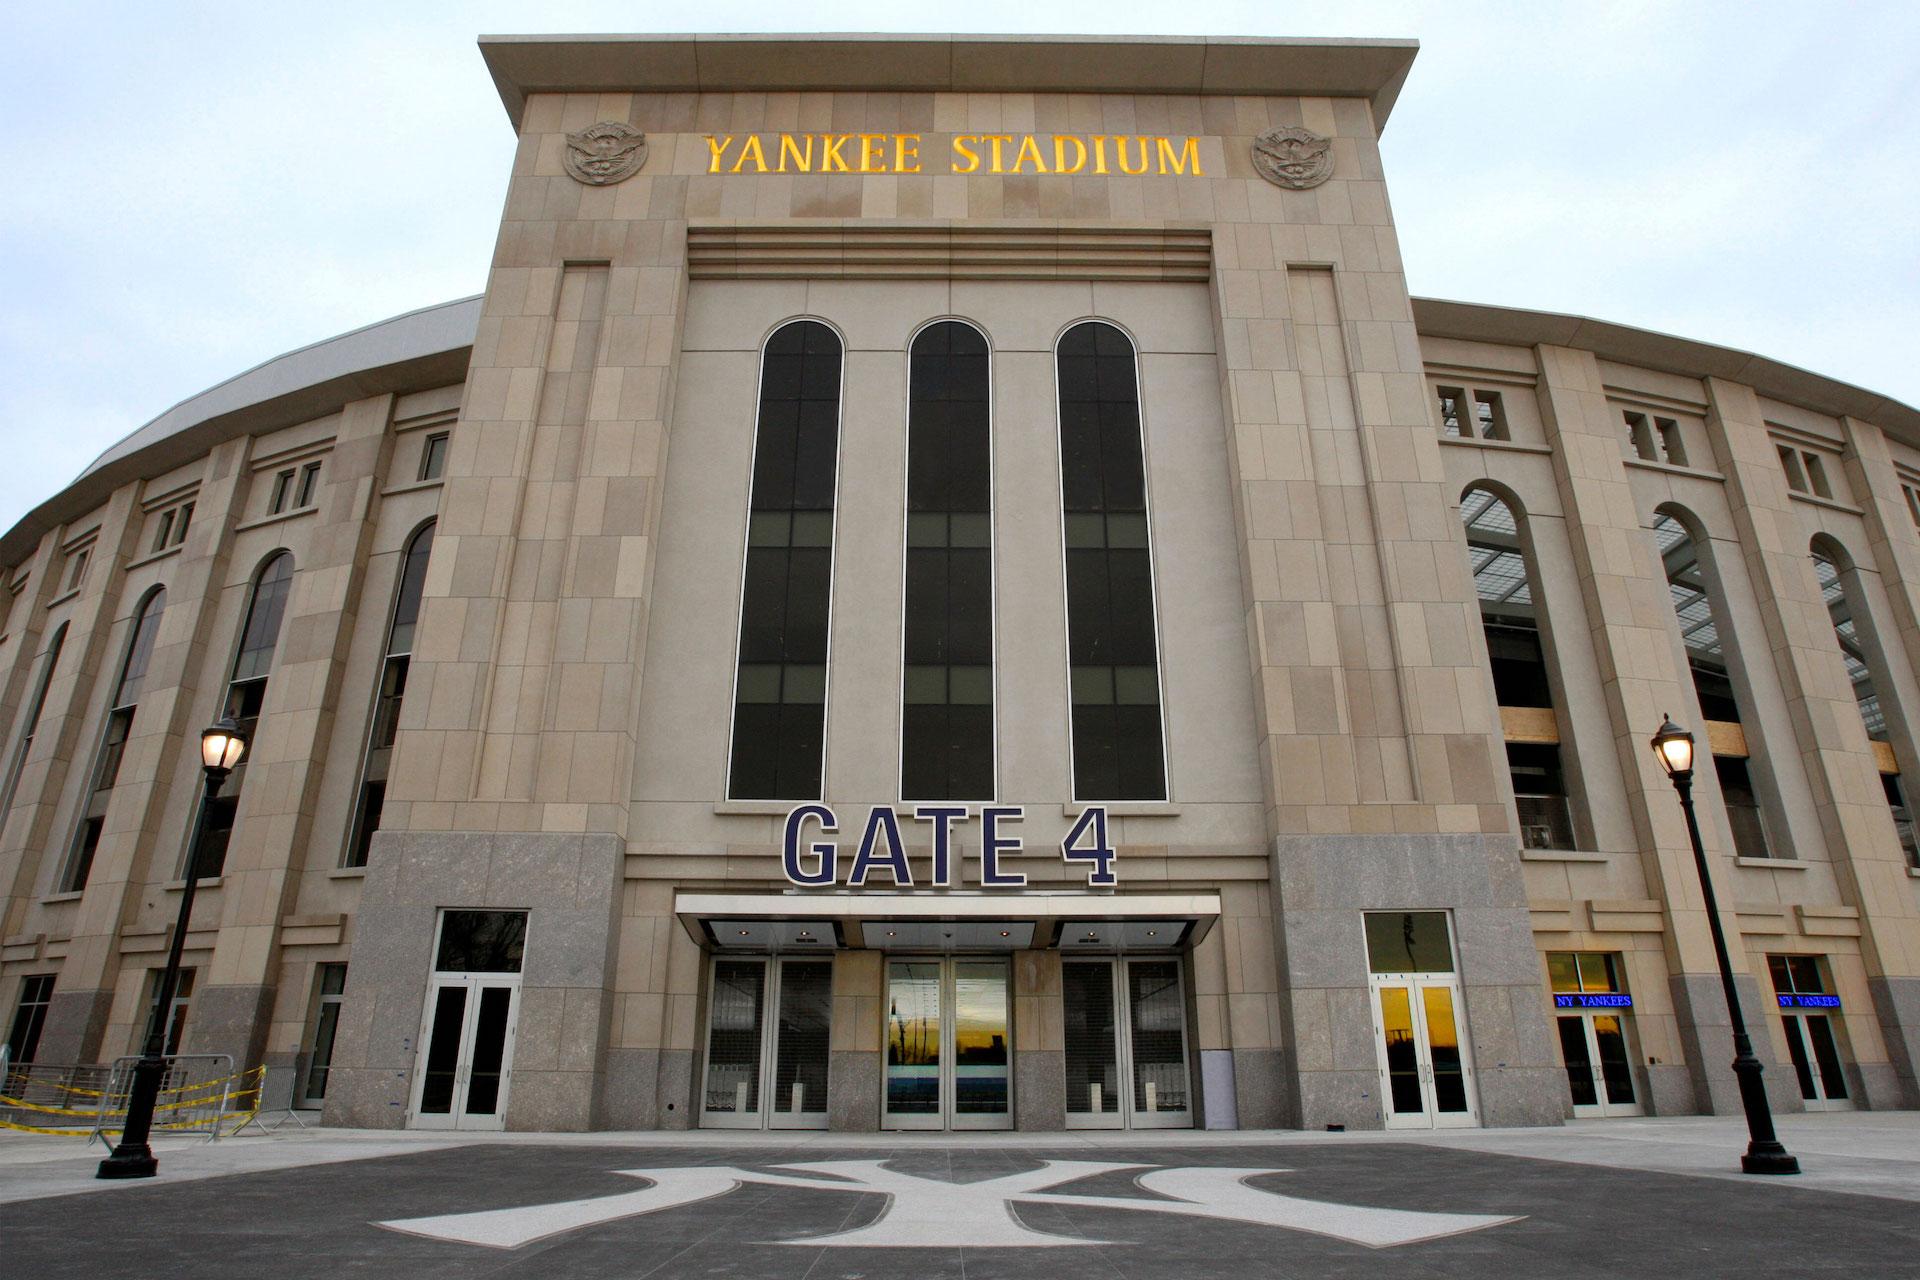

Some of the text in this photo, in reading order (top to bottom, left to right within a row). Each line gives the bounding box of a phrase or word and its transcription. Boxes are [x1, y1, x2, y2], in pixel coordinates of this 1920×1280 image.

[703, 133, 1205, 176] YANKEE STADIUM
[781, 803, 1118, 887] GATE 4
[1556, 995, 1632, 1007] NY YANKEES
[1778, 995, 1840, 1007] NY YANKEES
